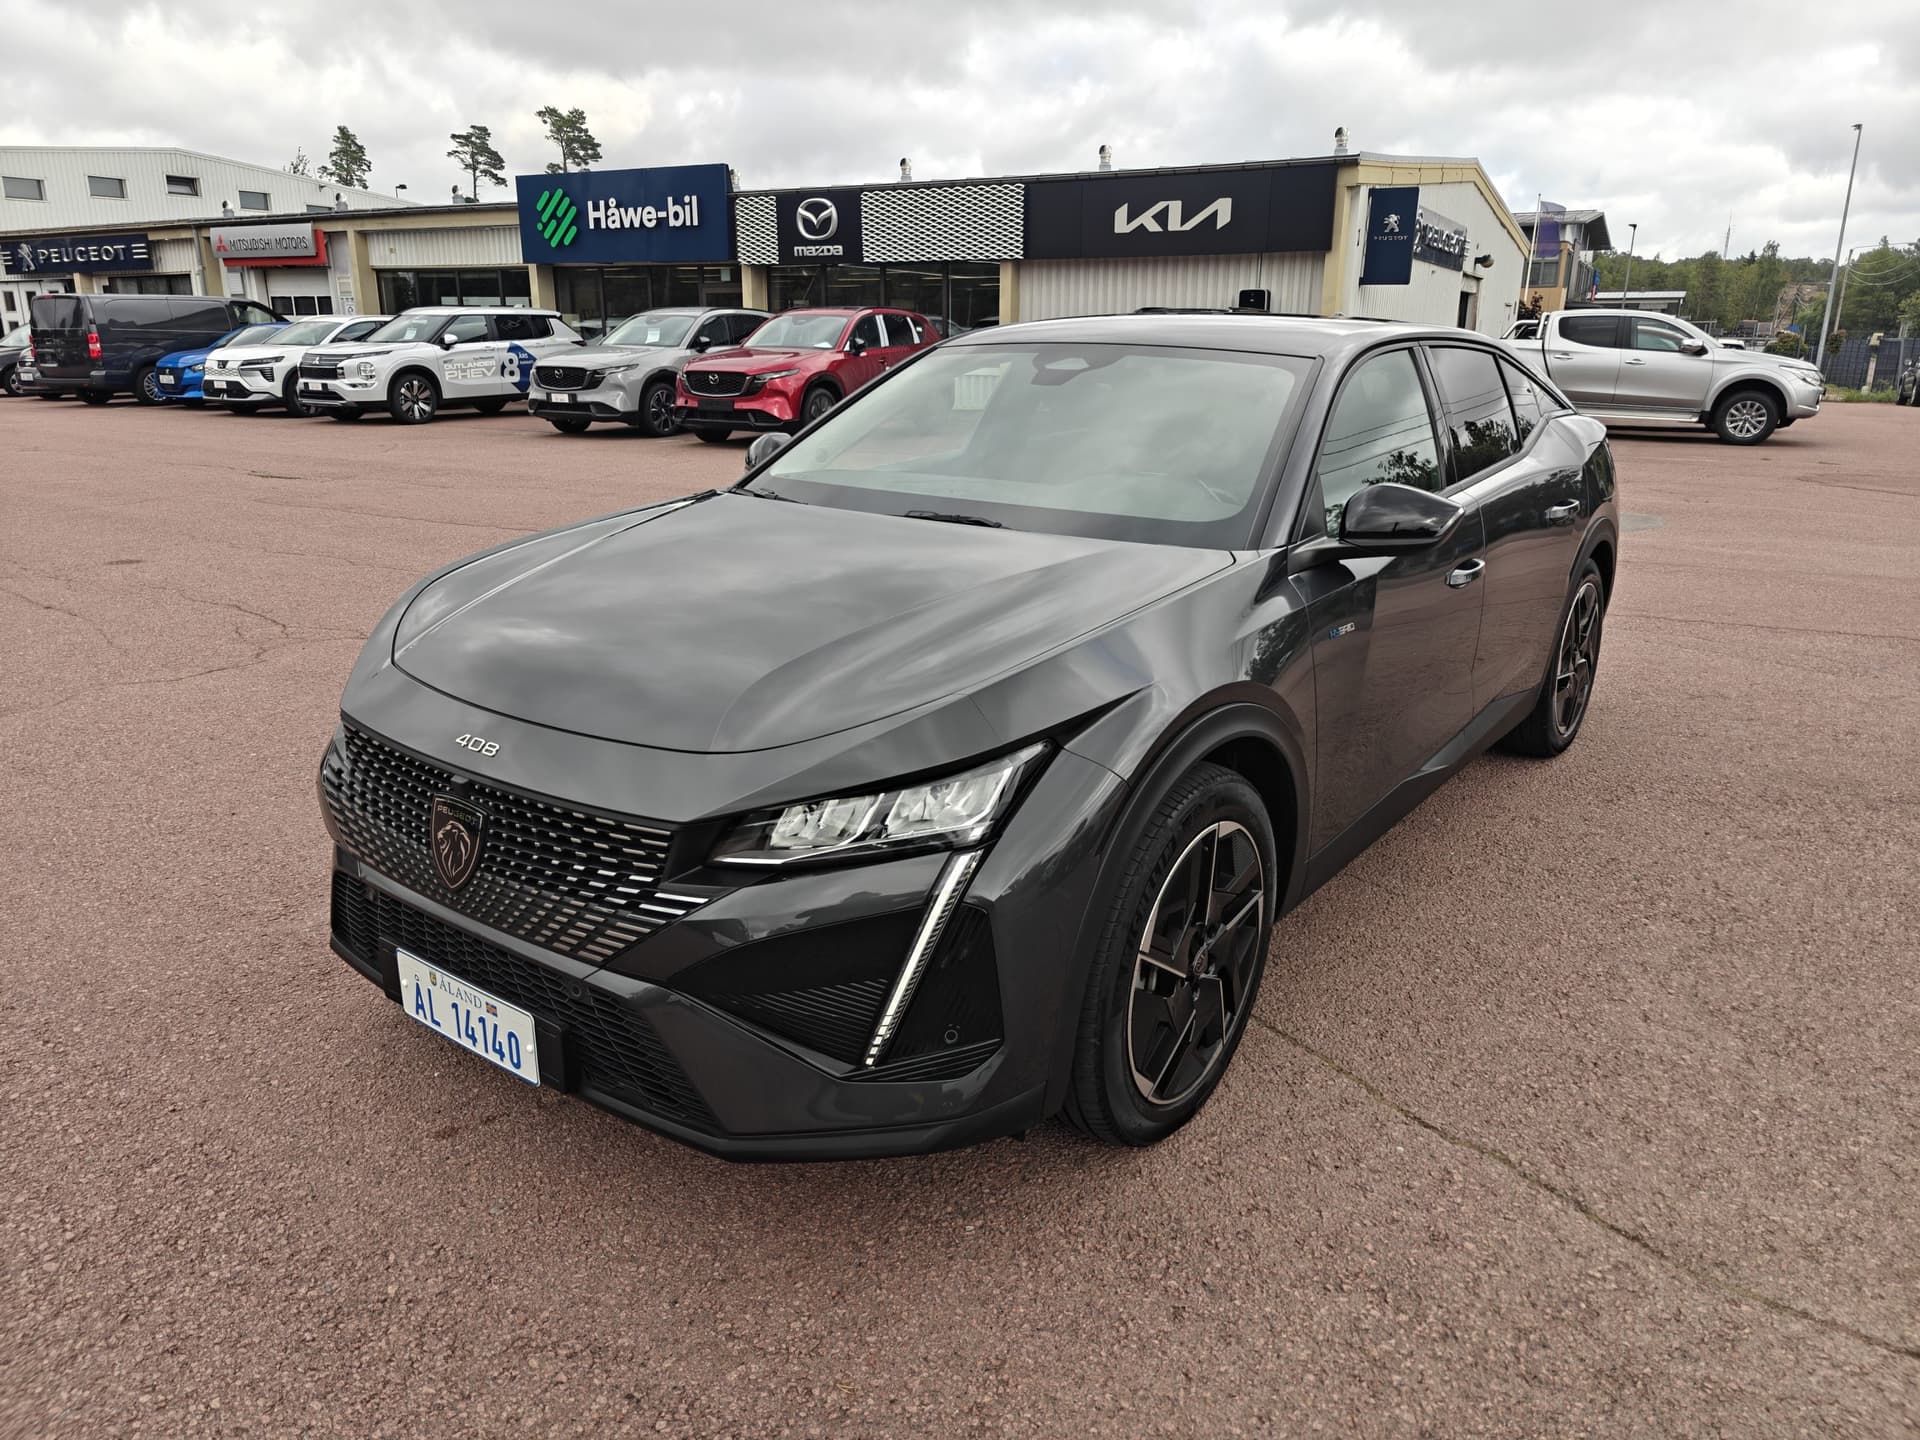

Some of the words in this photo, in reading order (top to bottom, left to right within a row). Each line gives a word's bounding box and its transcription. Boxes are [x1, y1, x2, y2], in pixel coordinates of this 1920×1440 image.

[587, 195, 698, 230] Håwe-bil
[1114, 197, 1232, 234] KIA
[37, 245, 126, 264] PEUGEOT
[229, 237, 272, 252] MITSUBISHI
[274, 236, 309, 250] MOTORS
[444, 360, 496, 370] OUTLANDER
[445, 367, 497, 381] PHEV
[455, 734, 500, 757] 408
[437, 804, 478, 825] PEUGEOT
[451, 1002, 521, 1070] 14140
